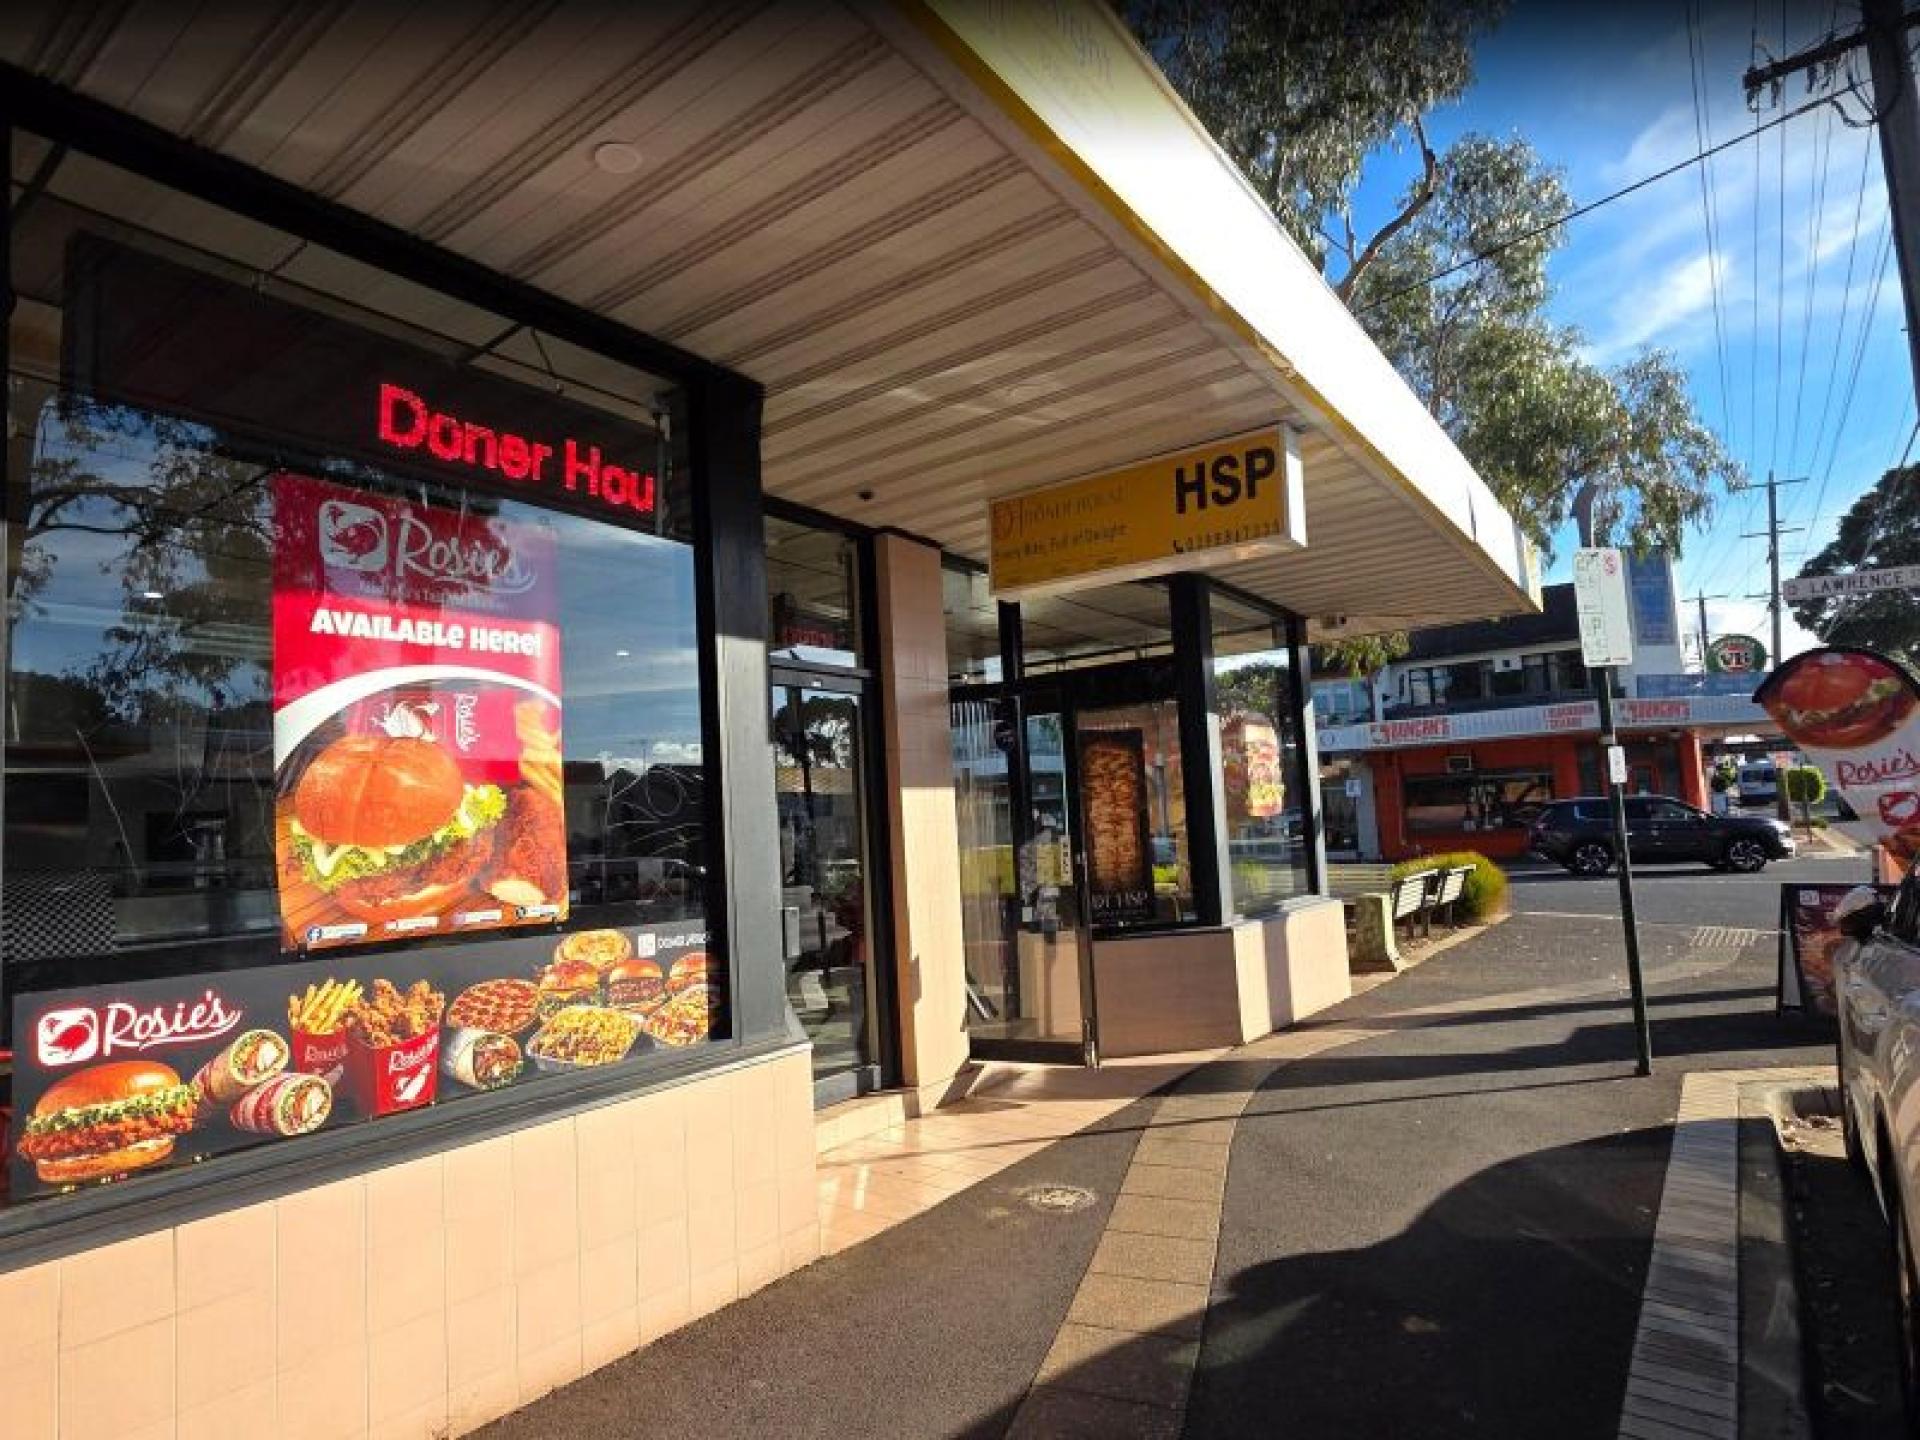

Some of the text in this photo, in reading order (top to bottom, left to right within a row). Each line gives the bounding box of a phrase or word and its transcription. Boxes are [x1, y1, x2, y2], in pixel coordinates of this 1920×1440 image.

[379, 383, 654, 513] Doner Hou
[1175, 446, 1275, 515] HSP
[1809, 571, 1904, 594] LAWRENCE
[1836, 747, 1920, 790] Rosie's
[102, 990, 242, 1057] Rosie's
